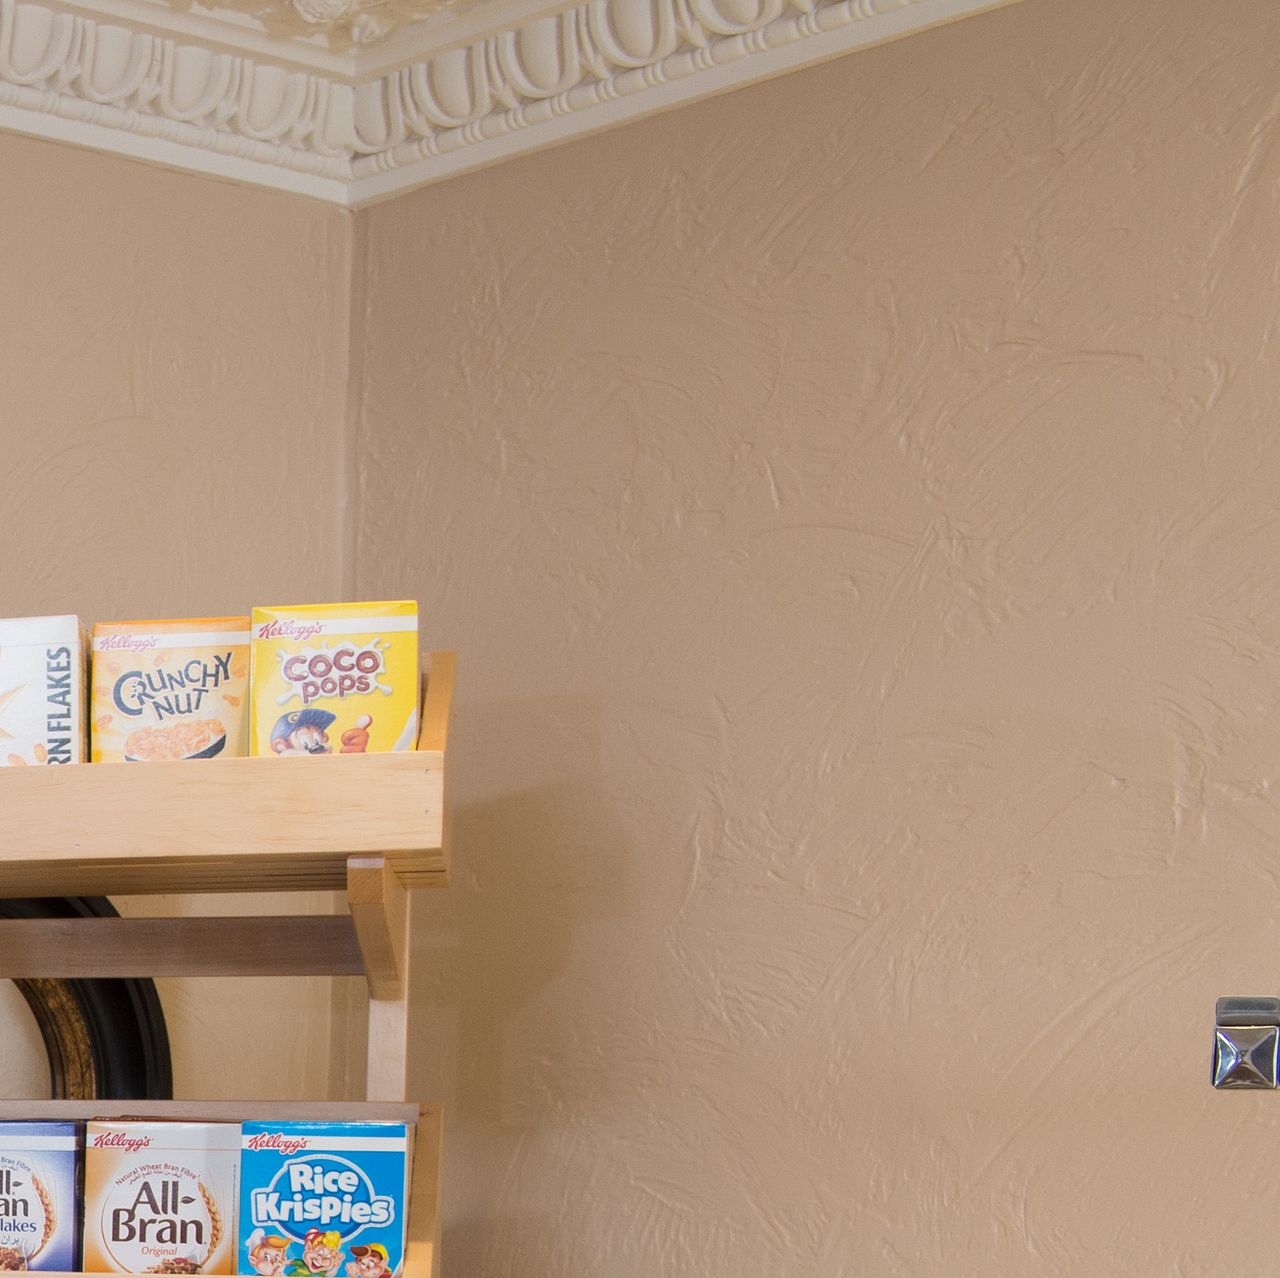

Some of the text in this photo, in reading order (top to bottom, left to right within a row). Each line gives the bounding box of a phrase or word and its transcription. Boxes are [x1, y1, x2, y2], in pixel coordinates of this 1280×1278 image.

[259, 620, 324, 640] Kellogg's
[100, 635, 158, 653] Kellogg's
[47, 646, 72, 732] FLAKES
[112, 652, 233, 716] CRUNCHY
[152, 687, 209, 721] NUT
[94, 1132, 151, 1152] Kellogg's
[248, 1133, 308, 1154] Kellogg's
[0, 1156, 16, 1166] Bran
[115, 1166, 139, 1186] Natural
[139, 1163, 162, 1172] Wheat
[164, 1162, 180, 1172] Bran
[289, 1163, 359, 1195] Rice
[255, 1192, 390, 1226] Krispies
[111, 1207, 204, 1246] Bran
[141, 1246, 178, 1258] Original
